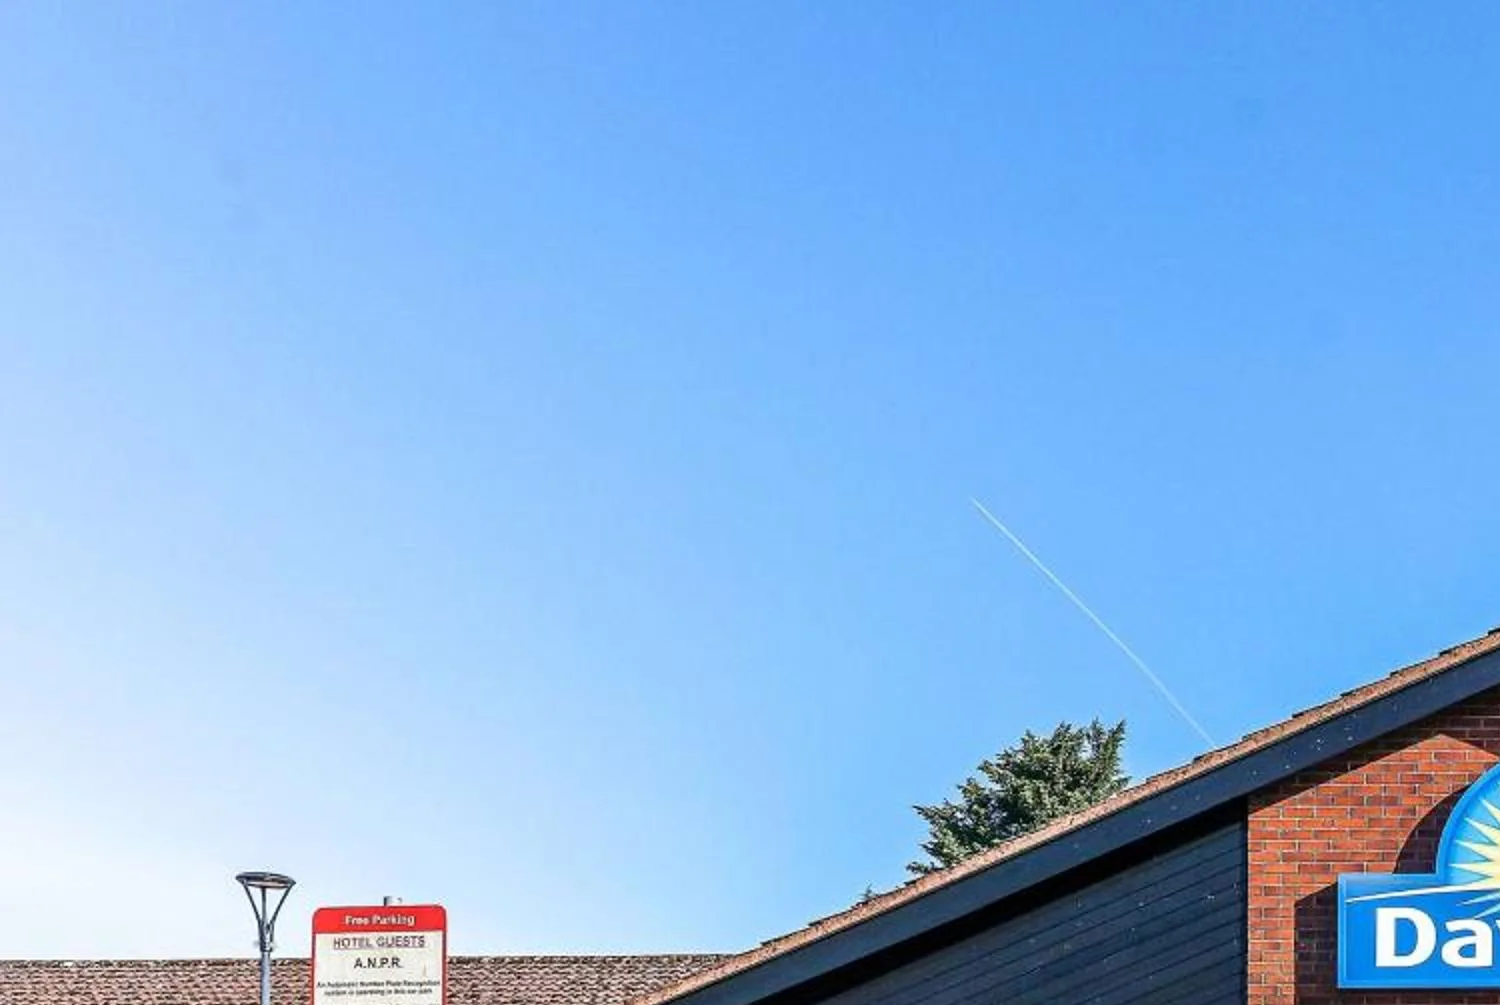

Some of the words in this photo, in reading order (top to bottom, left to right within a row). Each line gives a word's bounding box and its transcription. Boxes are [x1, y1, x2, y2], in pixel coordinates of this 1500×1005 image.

[345, 915, 370, 925] Free
[372, 914, 416, 927] Parking
[333, 937, 372, 949] HOTEL
[376, 935, 426, 948] GUESTS
